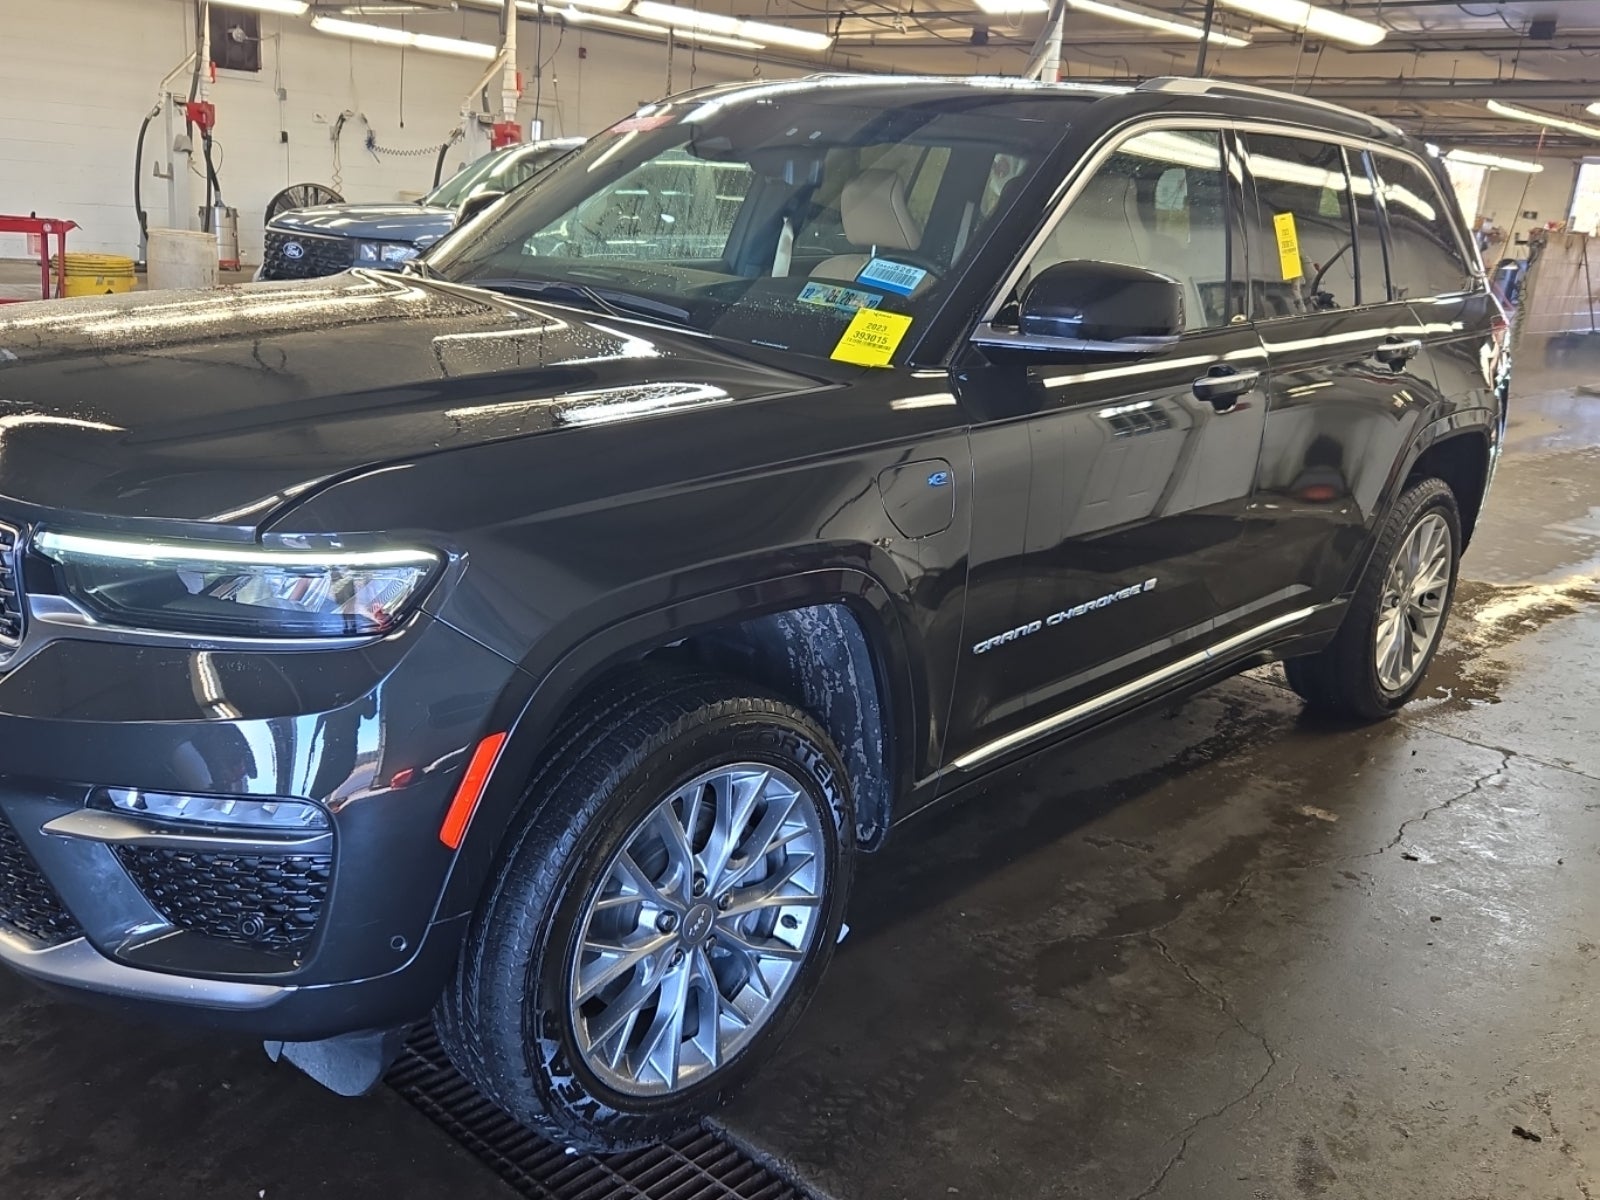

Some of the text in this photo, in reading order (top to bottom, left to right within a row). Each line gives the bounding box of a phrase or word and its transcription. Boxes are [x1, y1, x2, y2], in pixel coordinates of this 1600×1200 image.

[866, 322, 888, 333] 2023
[852, 330, 889, 345] 393015
[973, 583, 1142, 655] GRAND CHEROKEE
